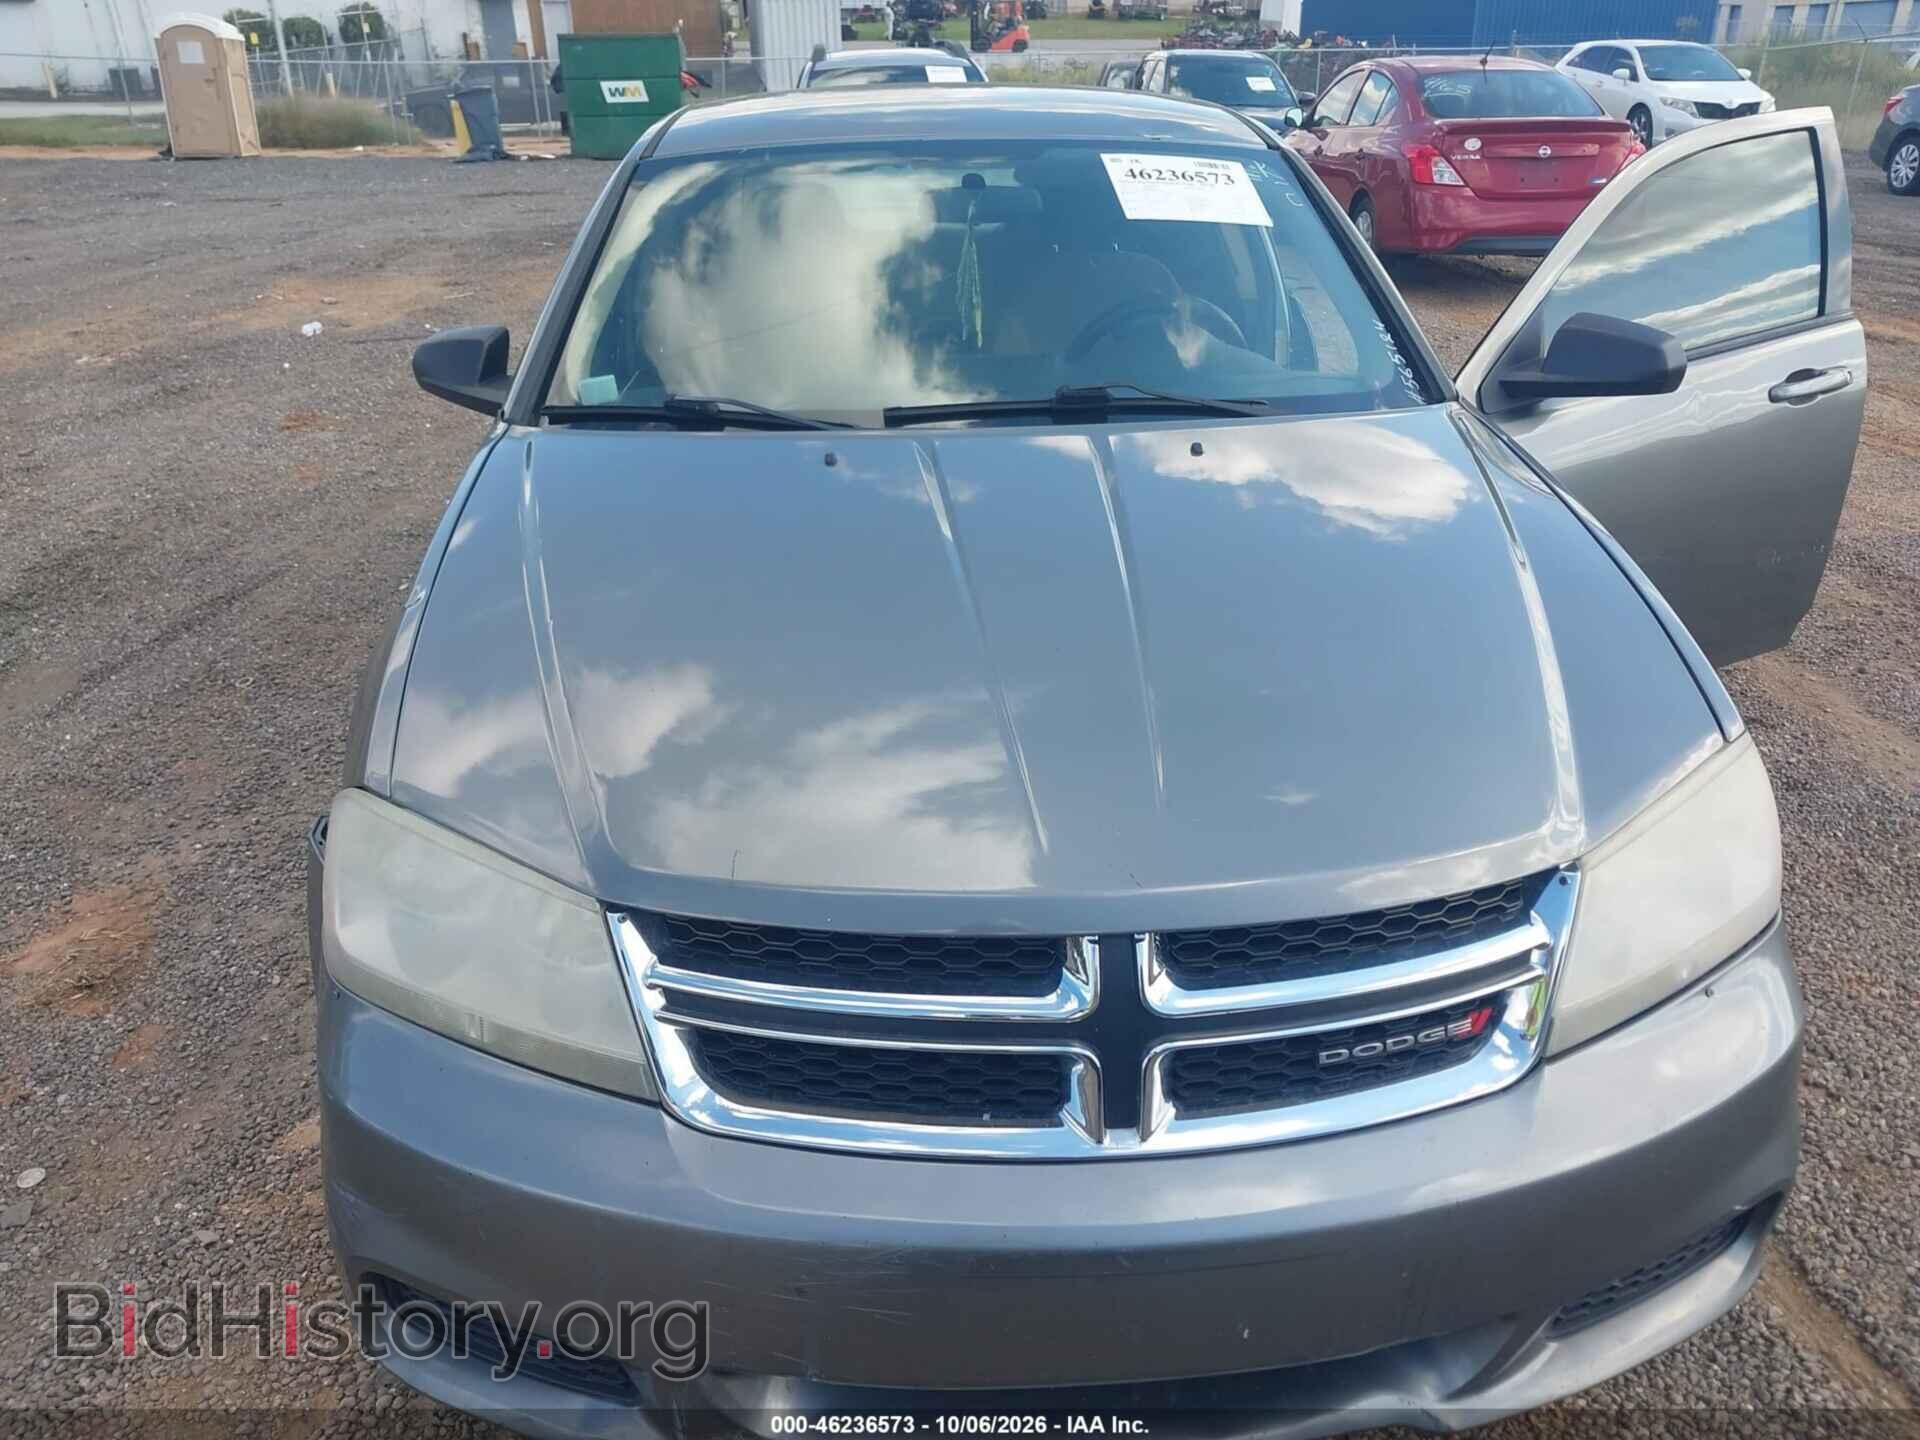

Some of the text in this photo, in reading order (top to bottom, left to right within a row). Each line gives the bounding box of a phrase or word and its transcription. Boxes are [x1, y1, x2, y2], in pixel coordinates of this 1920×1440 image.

[608, 87, 643, 97] WM
[1123, 168, 1236, 186] 46236573
[1318, 1018, 1473, 1064] DODGE
